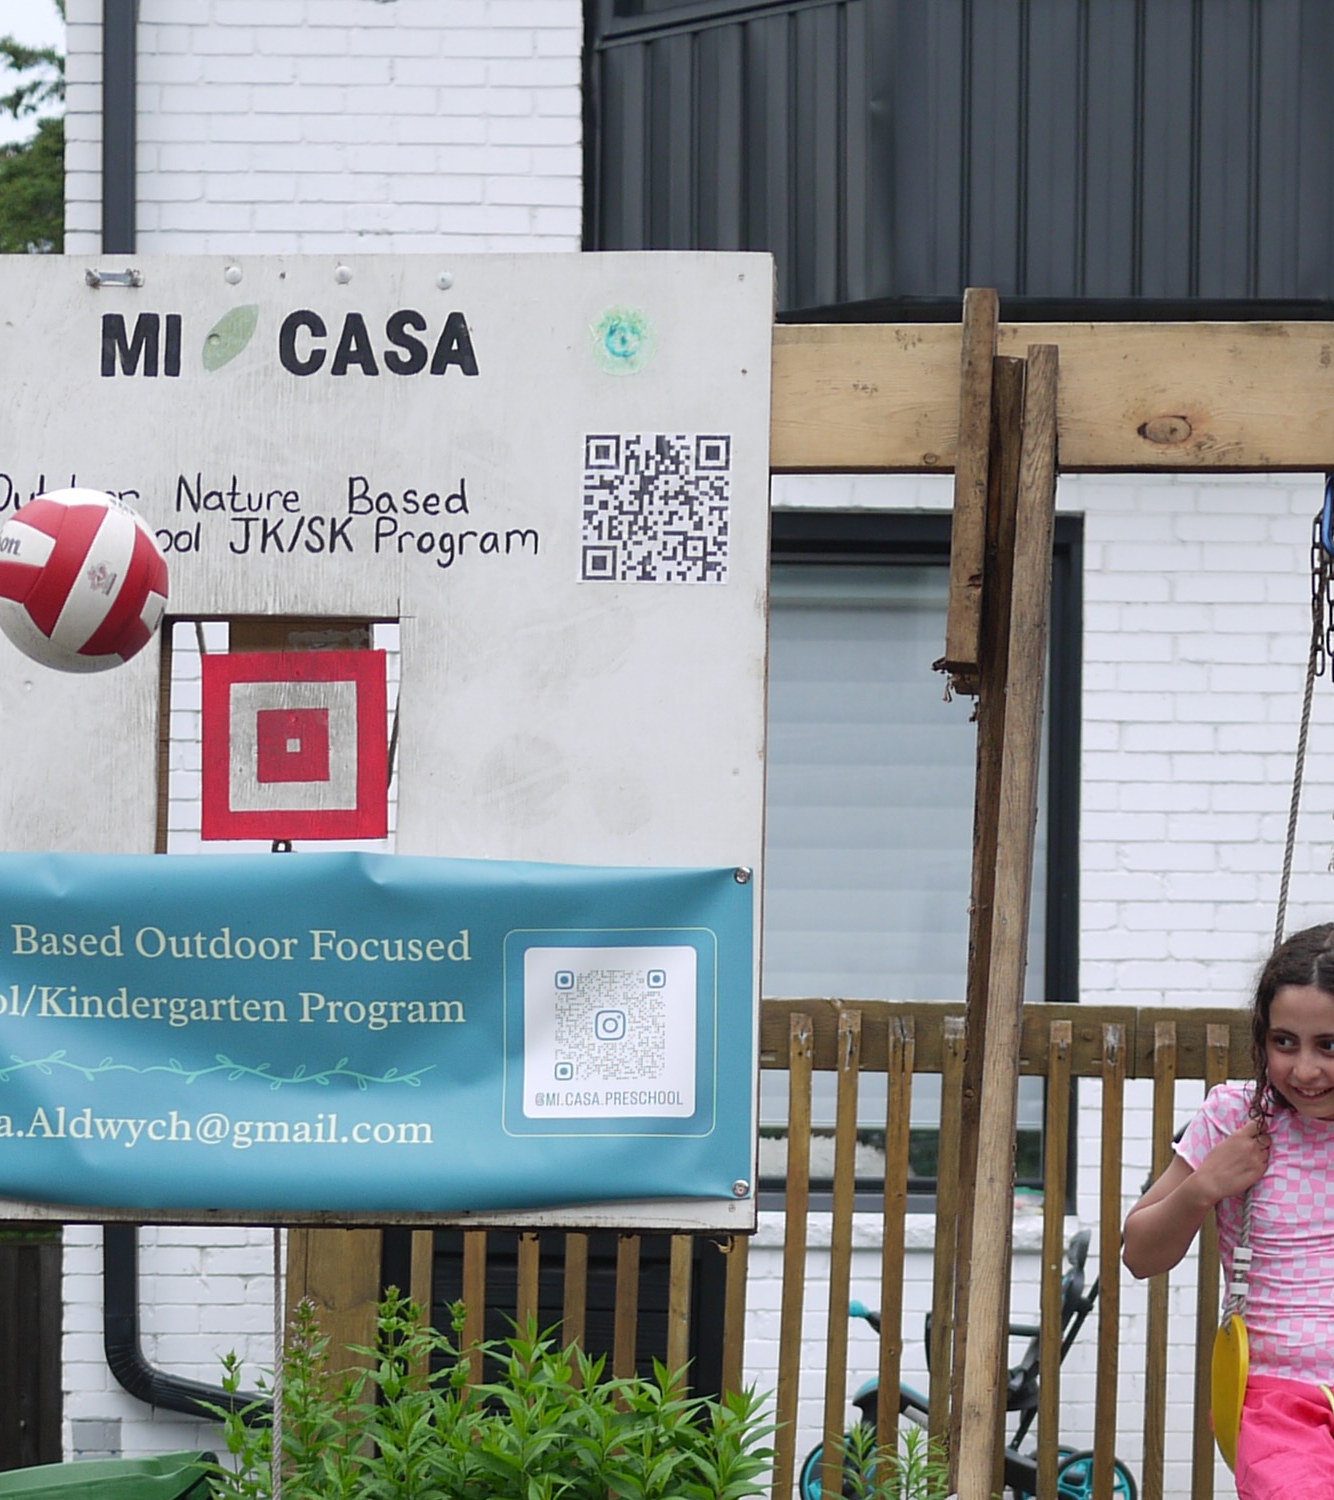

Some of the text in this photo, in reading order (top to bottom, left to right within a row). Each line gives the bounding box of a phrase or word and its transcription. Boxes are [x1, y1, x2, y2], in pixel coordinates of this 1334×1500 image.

[100, 309, 480, 378] MI CASA
[175, 472, 302, 516] Nature
[348, 474, 470, 515] Based
[228, 515, 355, 554] JK/SK
[373, 524, 540, 569] Program
[12, 924, 124, 957] Based
[135, 927, 298, 960] Outdoor
[309, 929, 472, 962] Focused
[299, 992, 466, 1031] Program
[535, 1090, 683, 1107] @MI.CASA.PRESCHOOL
